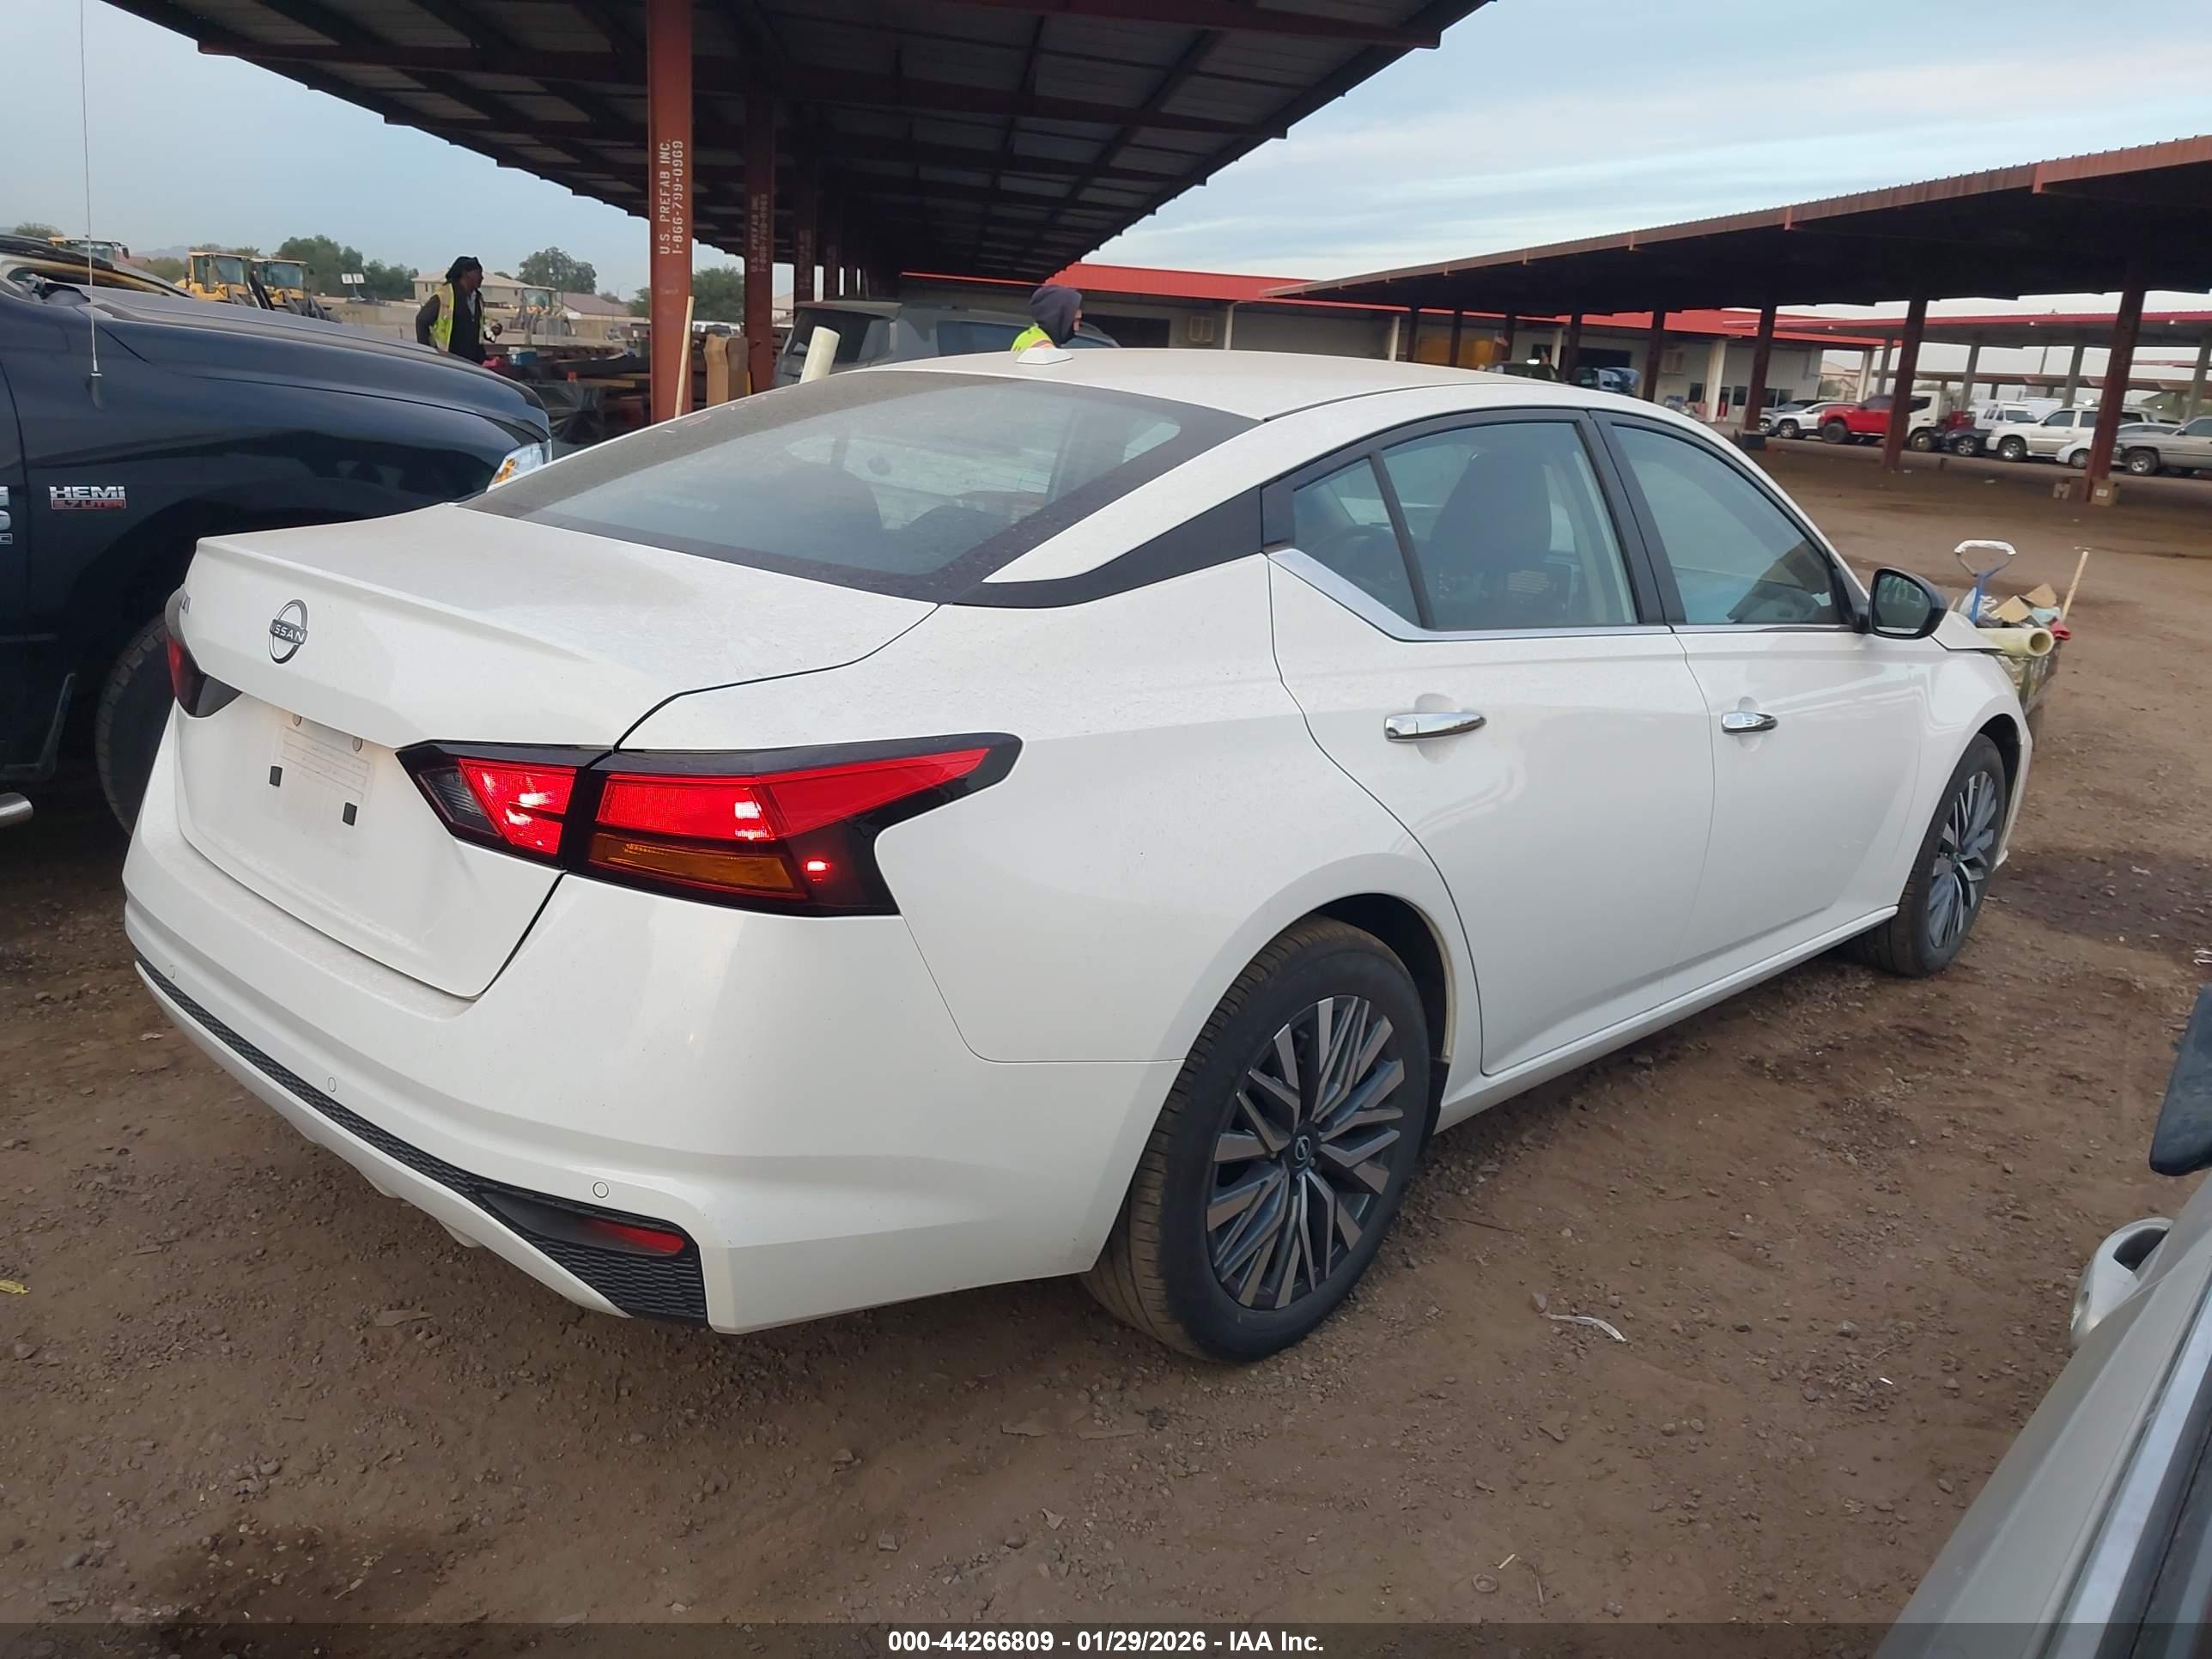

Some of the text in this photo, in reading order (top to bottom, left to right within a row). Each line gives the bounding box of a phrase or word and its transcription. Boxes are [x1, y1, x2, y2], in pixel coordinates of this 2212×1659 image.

[659, 138, 671, 255] U.S. PREFAB INC.
[672, 140, 684, 254] 1-866-799-0969
[49, 486, 125, 498] HEMI
